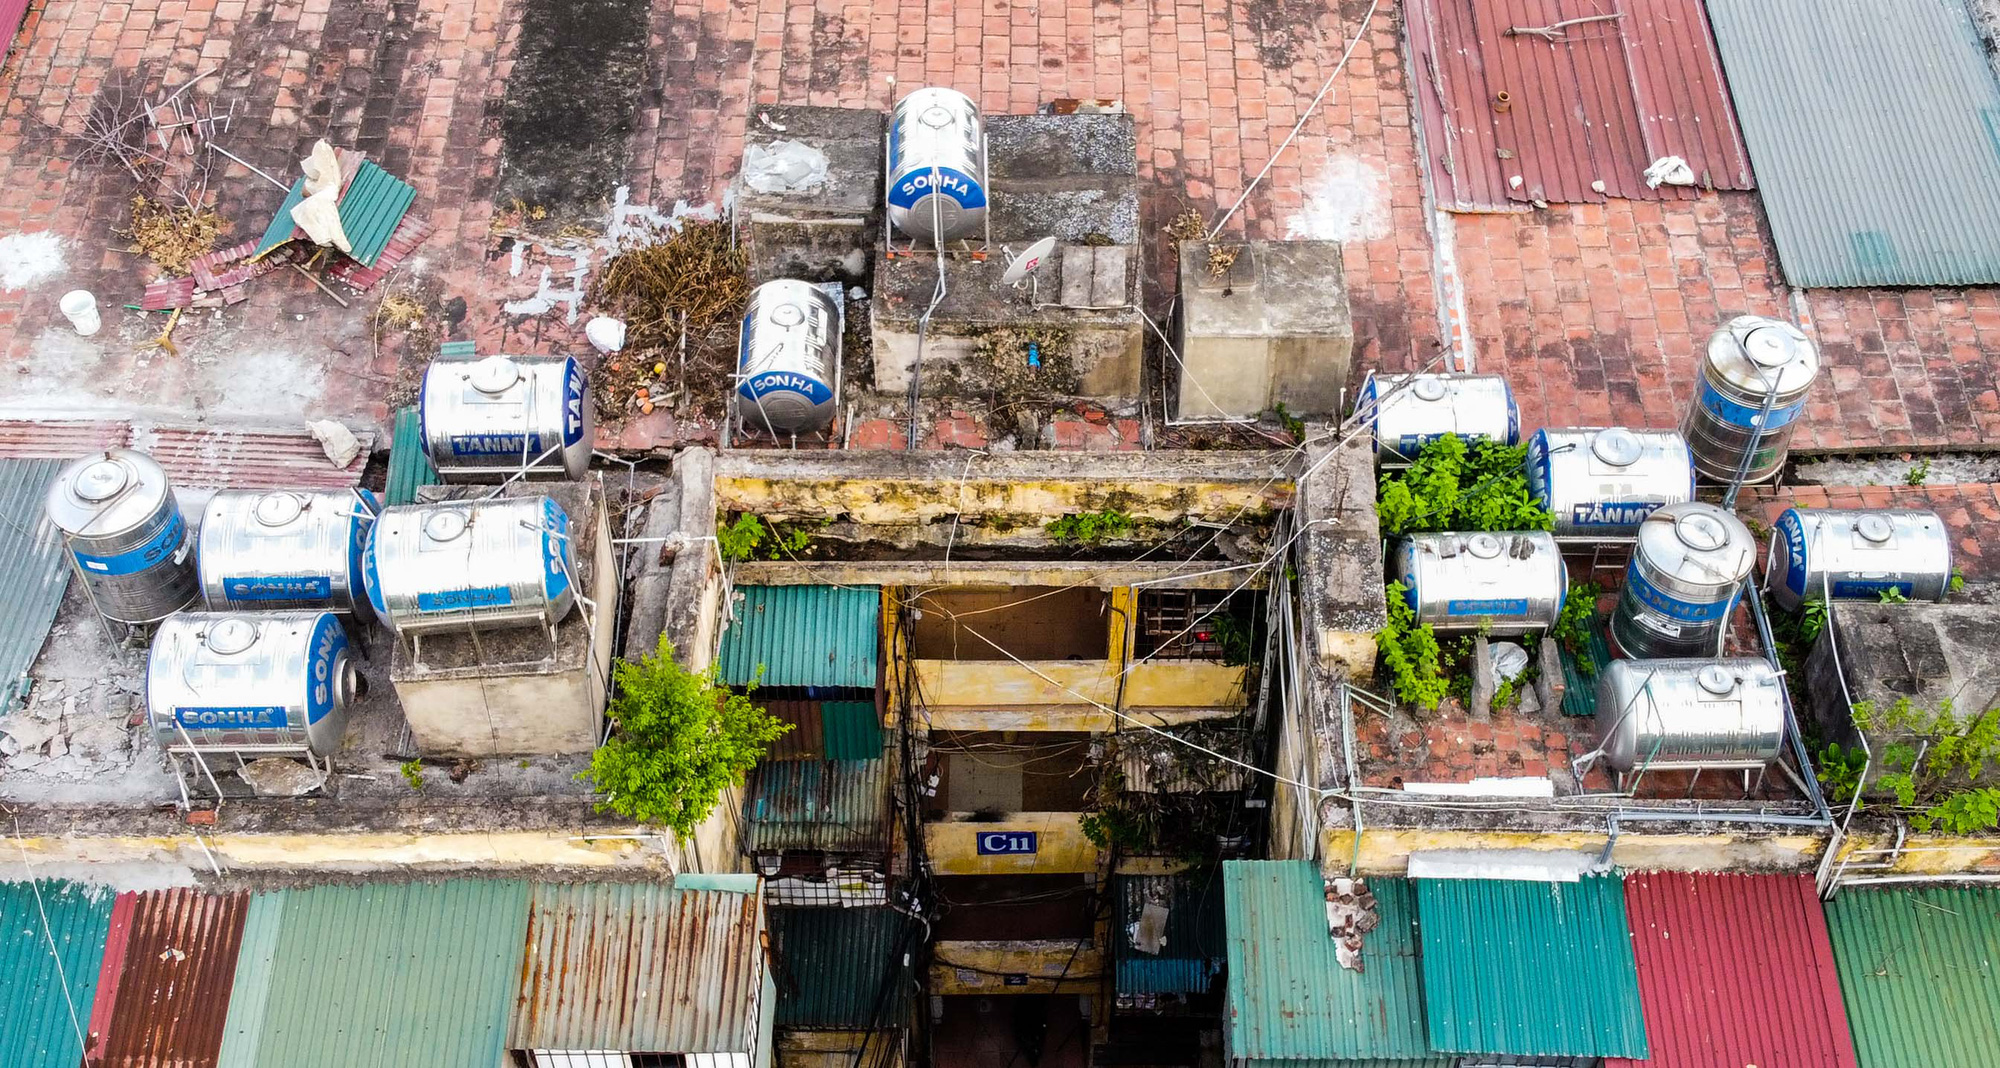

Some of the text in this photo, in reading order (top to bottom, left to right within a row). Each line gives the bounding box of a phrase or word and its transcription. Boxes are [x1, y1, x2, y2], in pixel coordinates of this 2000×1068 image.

[902, 174, 969, 196] SONHA
[754, 375, 814, 395] SONHA
[1781, 511, 1803, 568] SONHA
[233, 583, 318, 596] SONHA
[182, 710, 272, 725] SONHA
[984, 834, 1030, 852] C11
